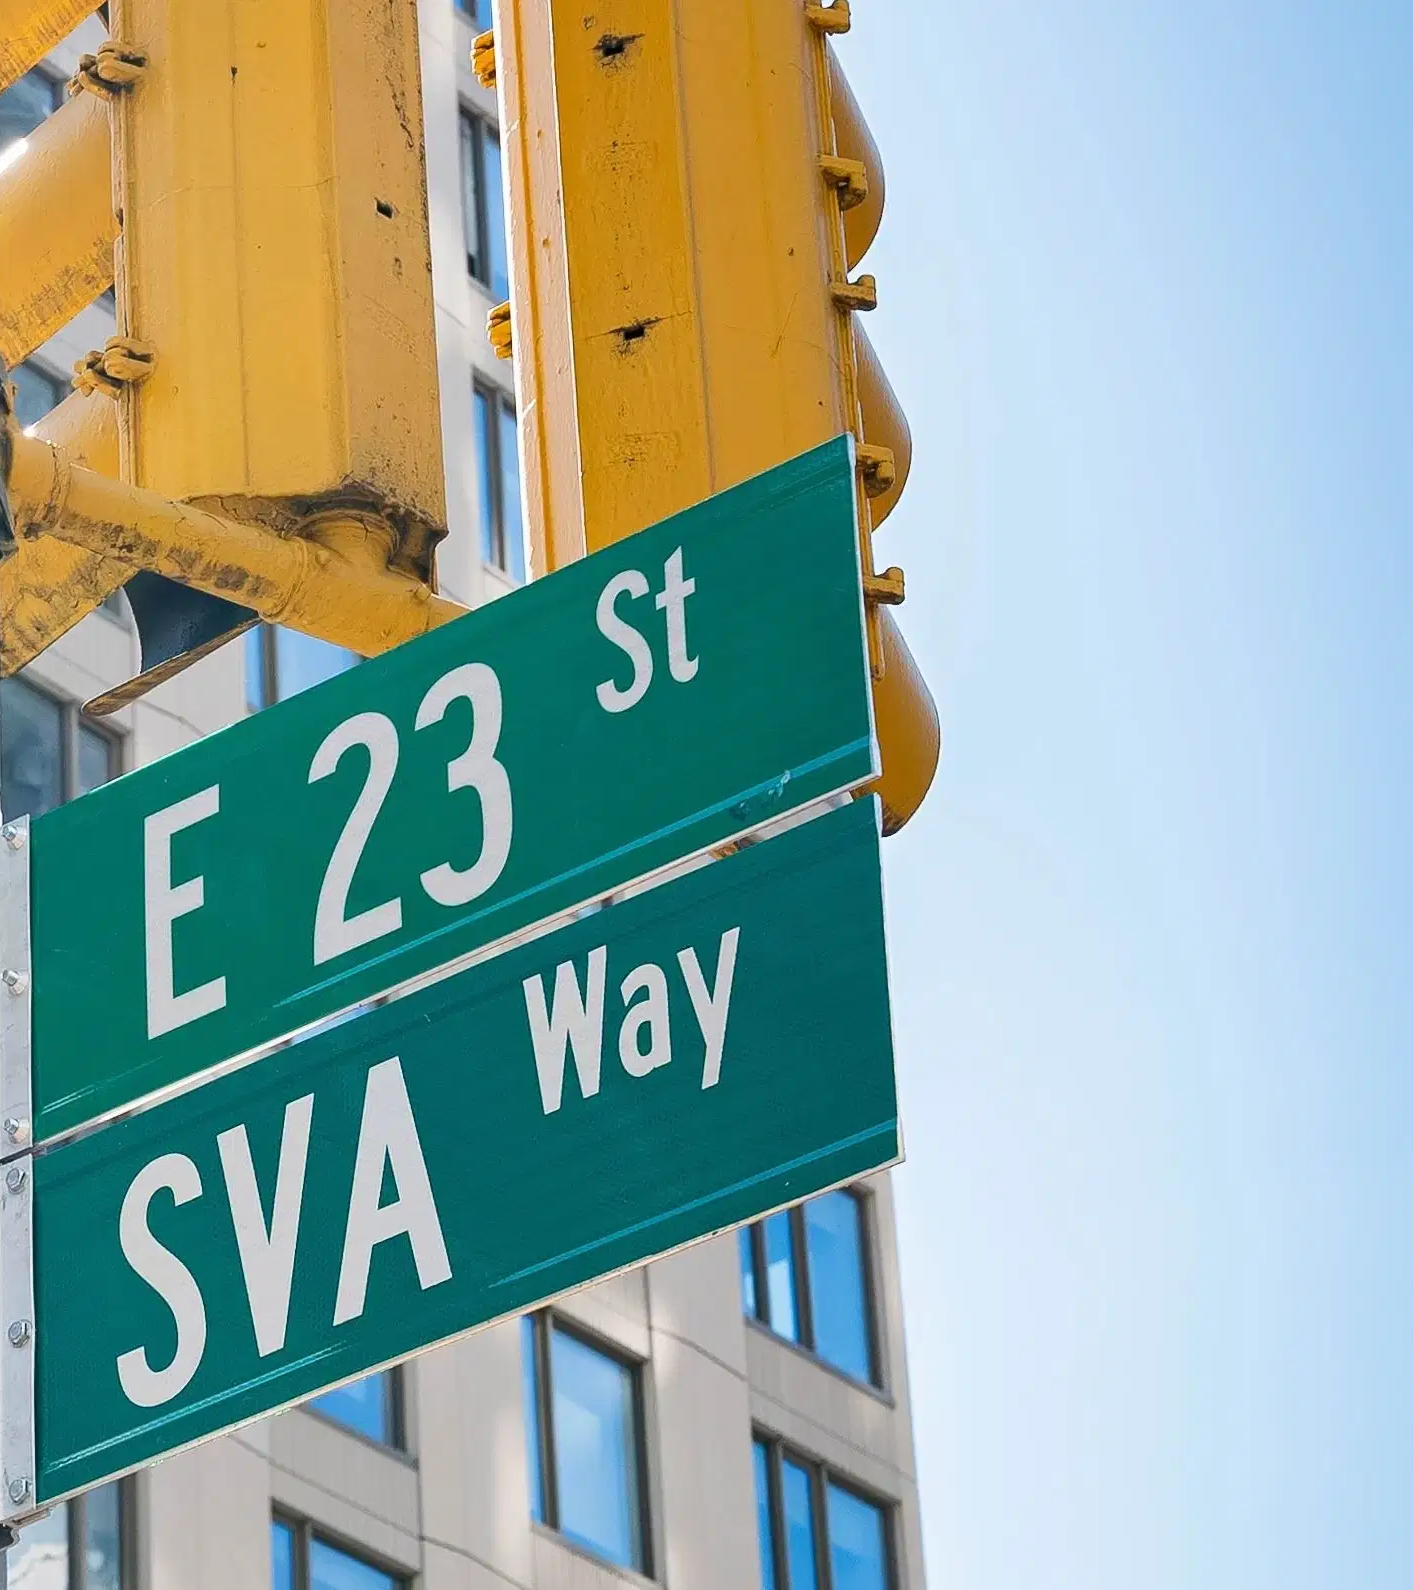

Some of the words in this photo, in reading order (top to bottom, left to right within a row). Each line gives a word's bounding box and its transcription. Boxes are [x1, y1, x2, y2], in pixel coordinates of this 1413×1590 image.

[143, 783, 228, 1041] E
[307, 661, 515, 967] 23
[594, 545, 701, 714] St
[115, 1055, 454, 1409] SVA
[522, 927, 741, 1116] Way
